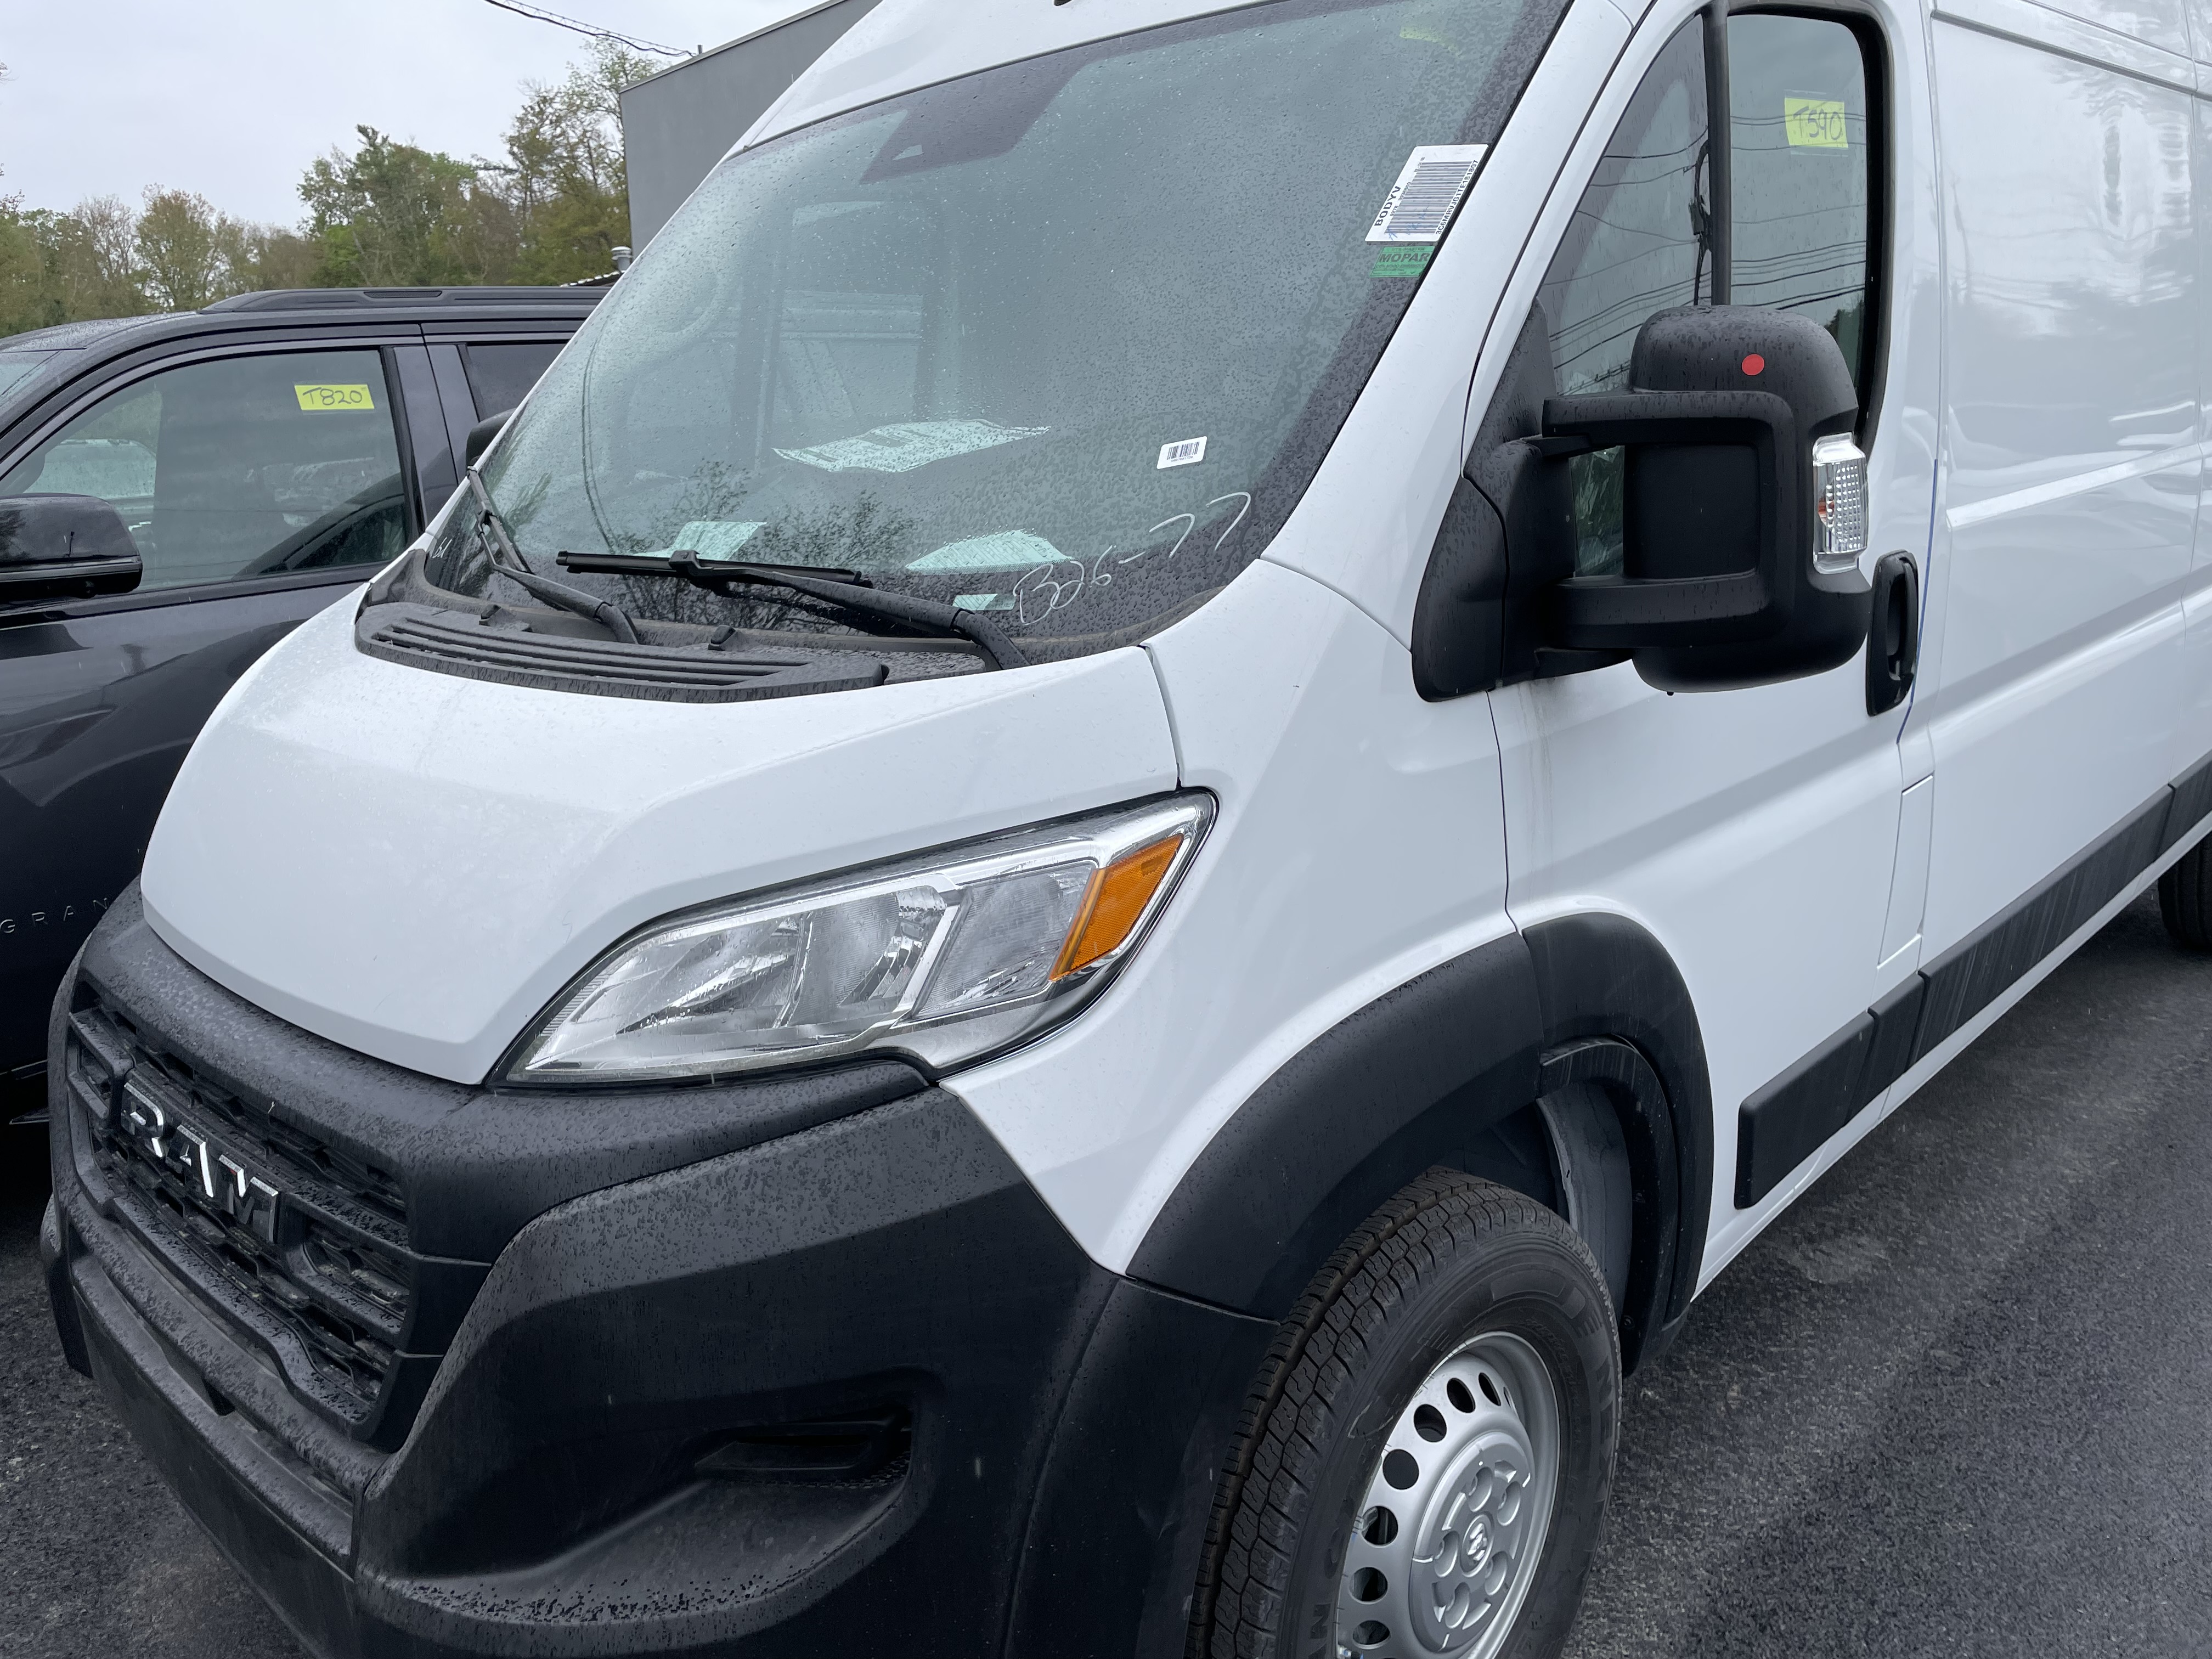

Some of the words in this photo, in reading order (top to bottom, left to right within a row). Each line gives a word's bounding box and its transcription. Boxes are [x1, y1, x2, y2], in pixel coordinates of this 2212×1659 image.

[1793, 106, 1842, 140] T590
[1374, 185, 1401, 226] BODYV
[1378, 253, 1430, 263] MOPAR
[302, 387, 362, 405] T820
[120, 1080, 279, 1243] RAM
